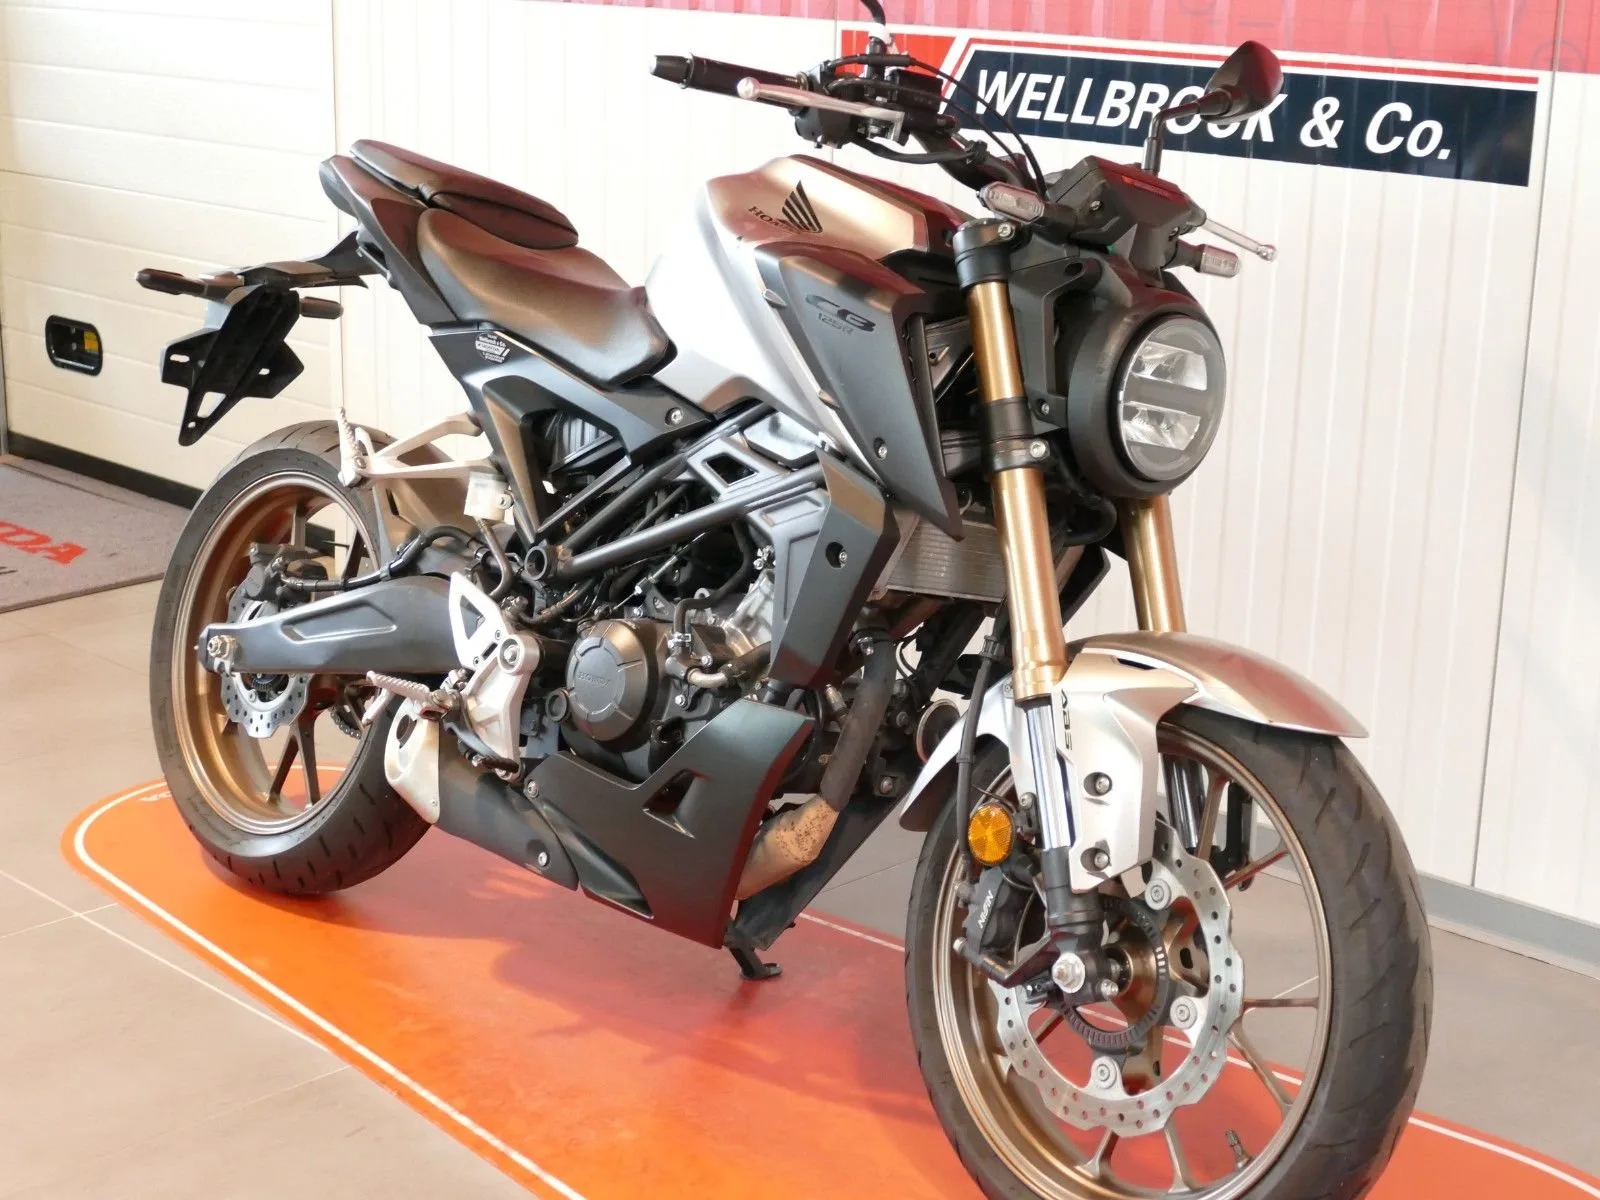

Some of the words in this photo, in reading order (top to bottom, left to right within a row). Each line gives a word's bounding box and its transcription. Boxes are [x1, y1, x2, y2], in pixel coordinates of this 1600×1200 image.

[975, 69, 1288, 143] WELLBROK
[1299, 96, 1345, 149] &
[1365, 102, 1451, 160] Co.
[805, 295, 876, 332] CB
